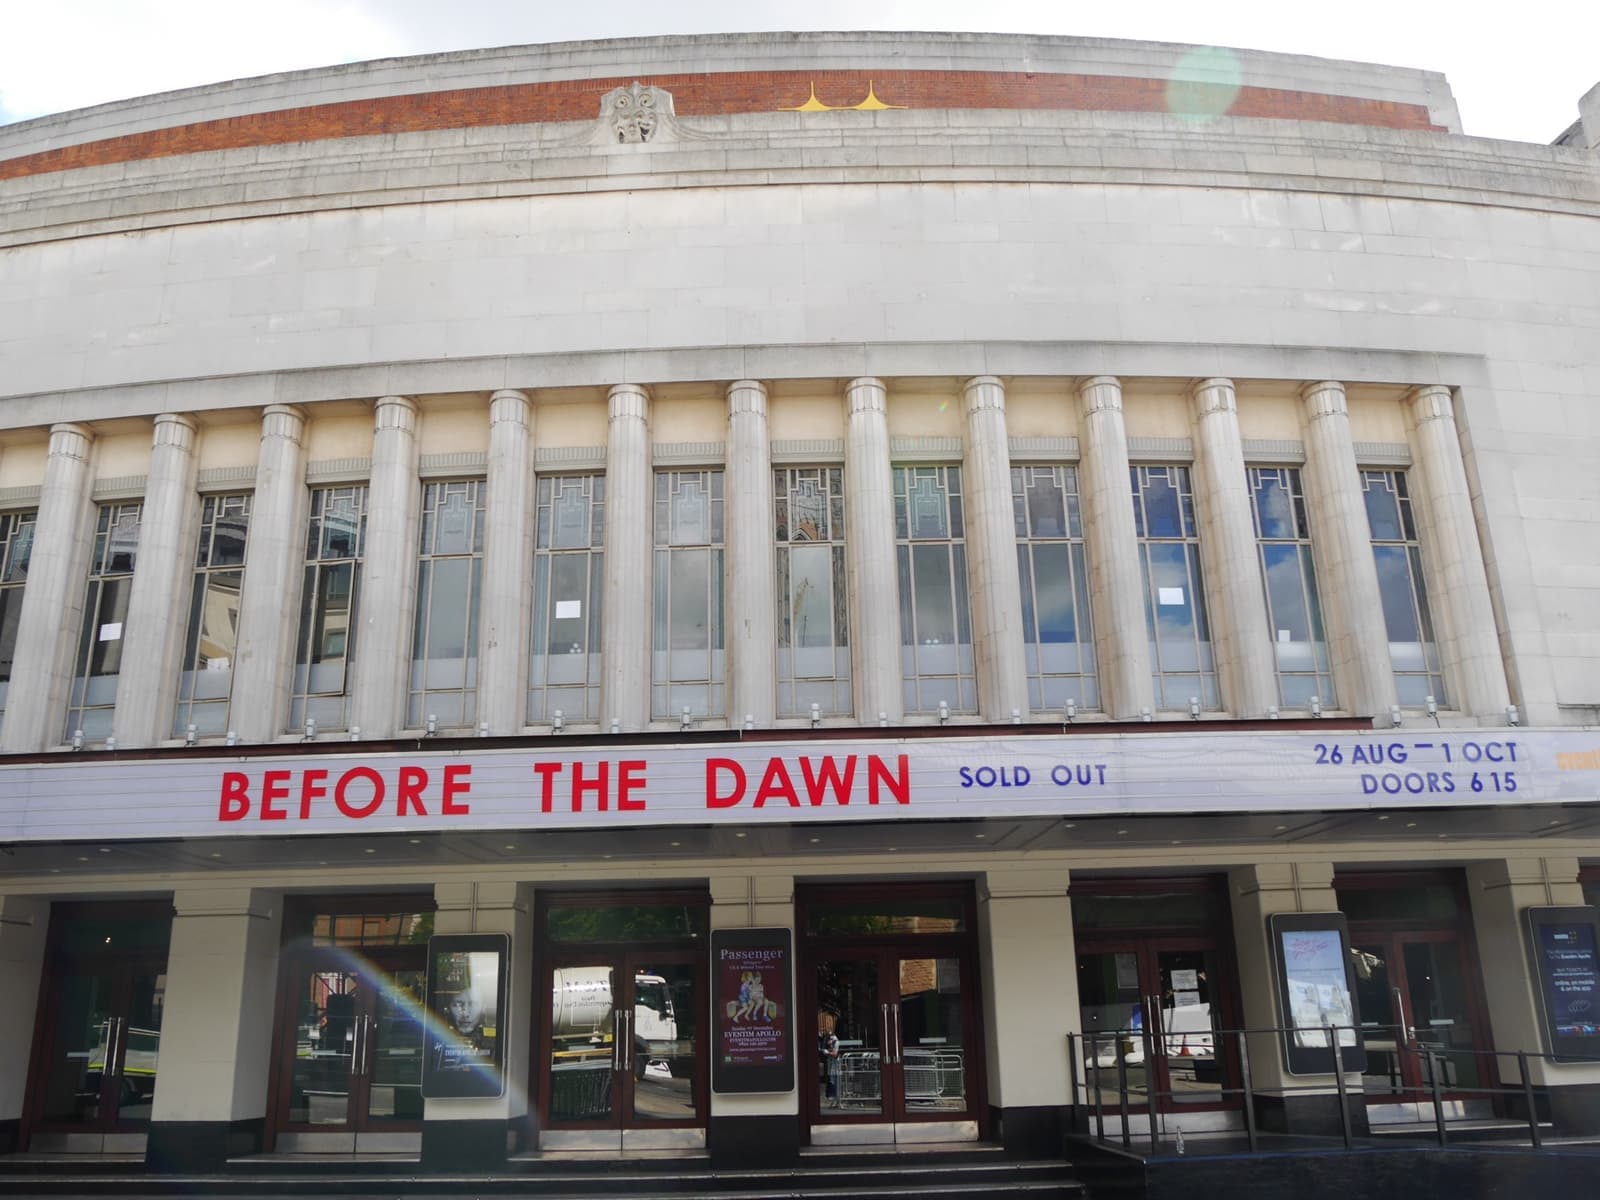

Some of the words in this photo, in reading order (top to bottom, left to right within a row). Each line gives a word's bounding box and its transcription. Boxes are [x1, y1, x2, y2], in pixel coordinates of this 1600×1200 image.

[1314, 743, 1344, 765] 26
[1352, 743, 1409, 765] AUG
[1442, 743, 1452, 762] 1
[1462, 742, 1517, 763] OCT
[218, 764, 472, 822] BEFORE
[533, 760, 647, 813] THE
[705, 754, 911, 810] DAWN
[959, 766, 1032, 788] SOLD
[1051, 764, 1107, 787] OUT
[1361, 771, 1456, 795] DOORS
[720, 949, 783, 961] Passenger
